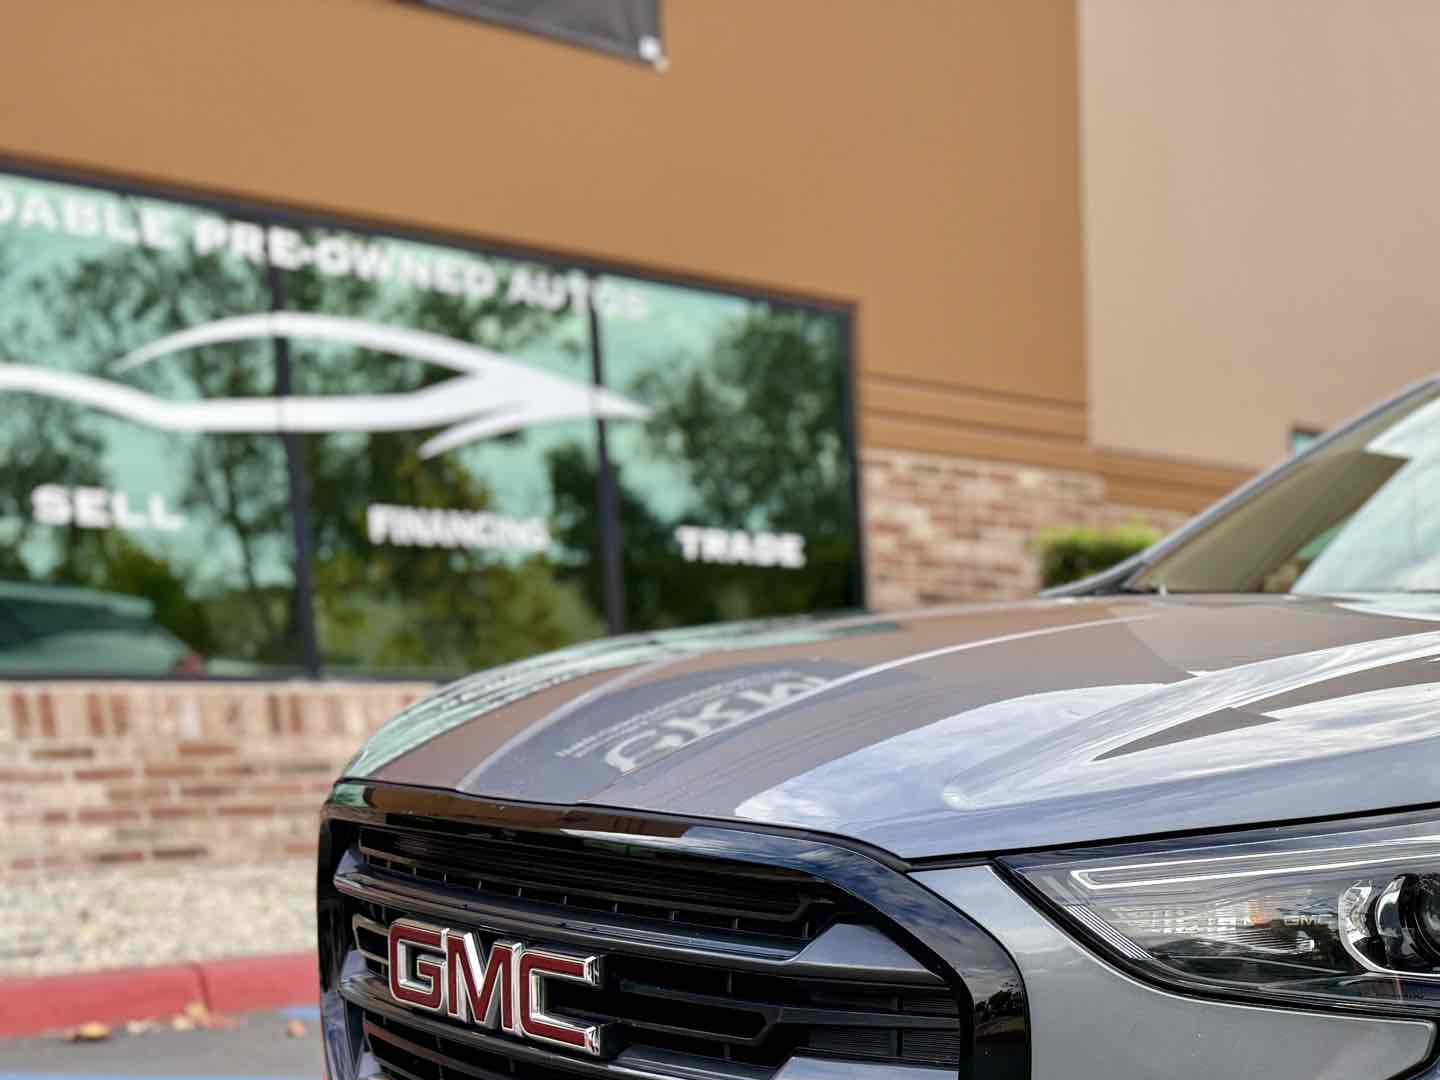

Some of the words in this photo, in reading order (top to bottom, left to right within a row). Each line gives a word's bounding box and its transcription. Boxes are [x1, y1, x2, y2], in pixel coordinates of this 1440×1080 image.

[31, 484, 188, 530] SELL
[367, 503, 551, 552] FINANCING
[674, 524, 807, 570] TRADE
[388, 918, 602, 1056] GMC
